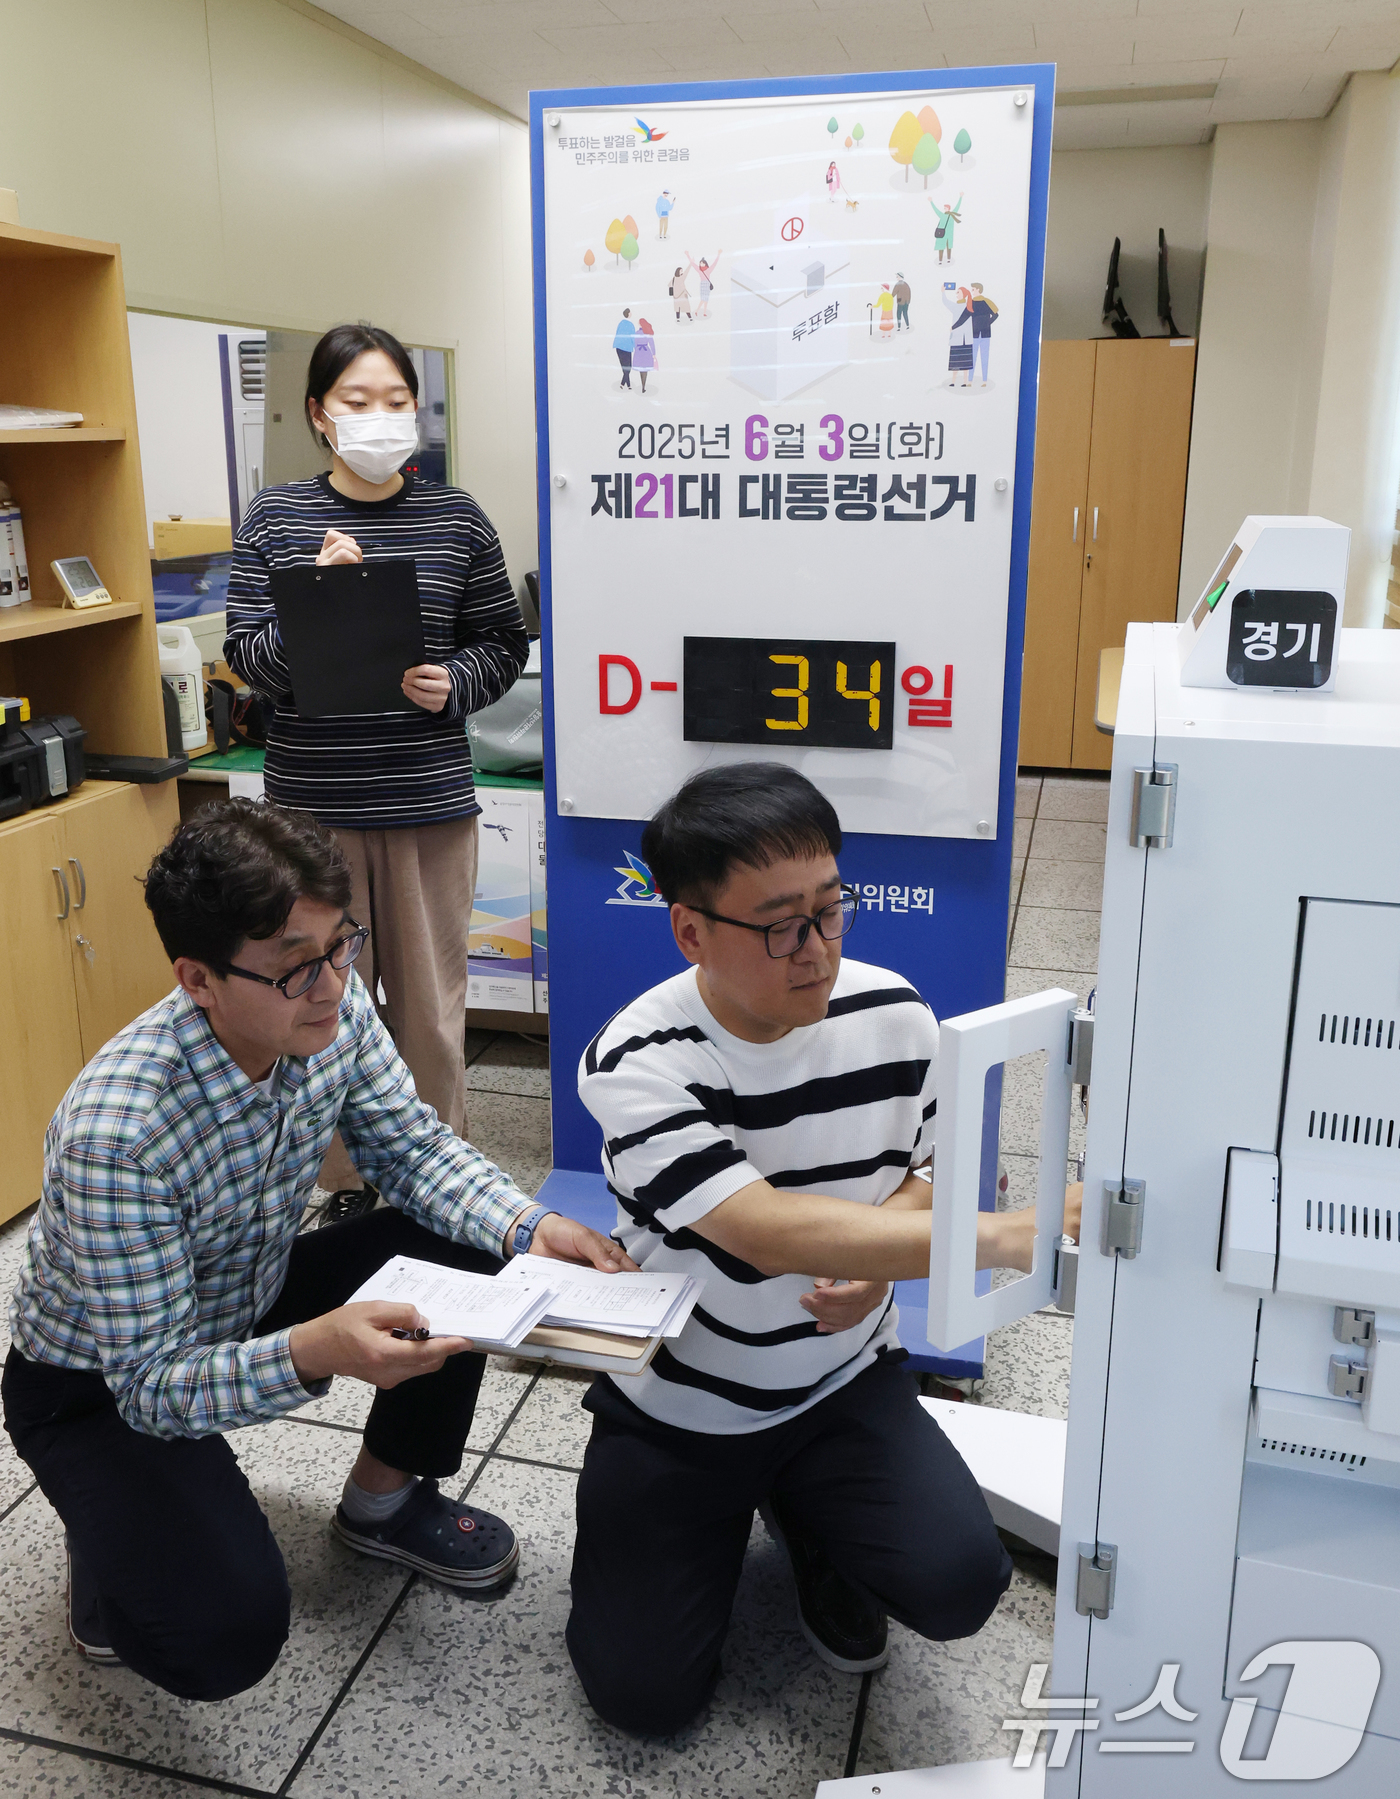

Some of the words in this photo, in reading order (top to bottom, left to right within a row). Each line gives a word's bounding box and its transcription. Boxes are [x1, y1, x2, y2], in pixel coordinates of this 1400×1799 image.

[558, 136, 600, 150] 투표하는
[603, 134, 636, 149] 발걸음
[575, 151, 629, 165] 민주주의를
[632, 150, 654, 163] 위한
[657, 148, 690, 162] 큰걸음
[792, 301, 840, 341] 투표함
[618, 423, 730, 459] 2025년
[745, 414, 804, 461] 6월
[818, 414, 944, 461] 3일(화)
[590, 473, 720, 520] 제21대
[738, 473, 976, 522] 대통령선거
[1242, 622, 1321, 662] 경기
[599, 655, 677, 715] D-
[765, 654, 881, 731] 34
[901, 664, 953, 727] 일
